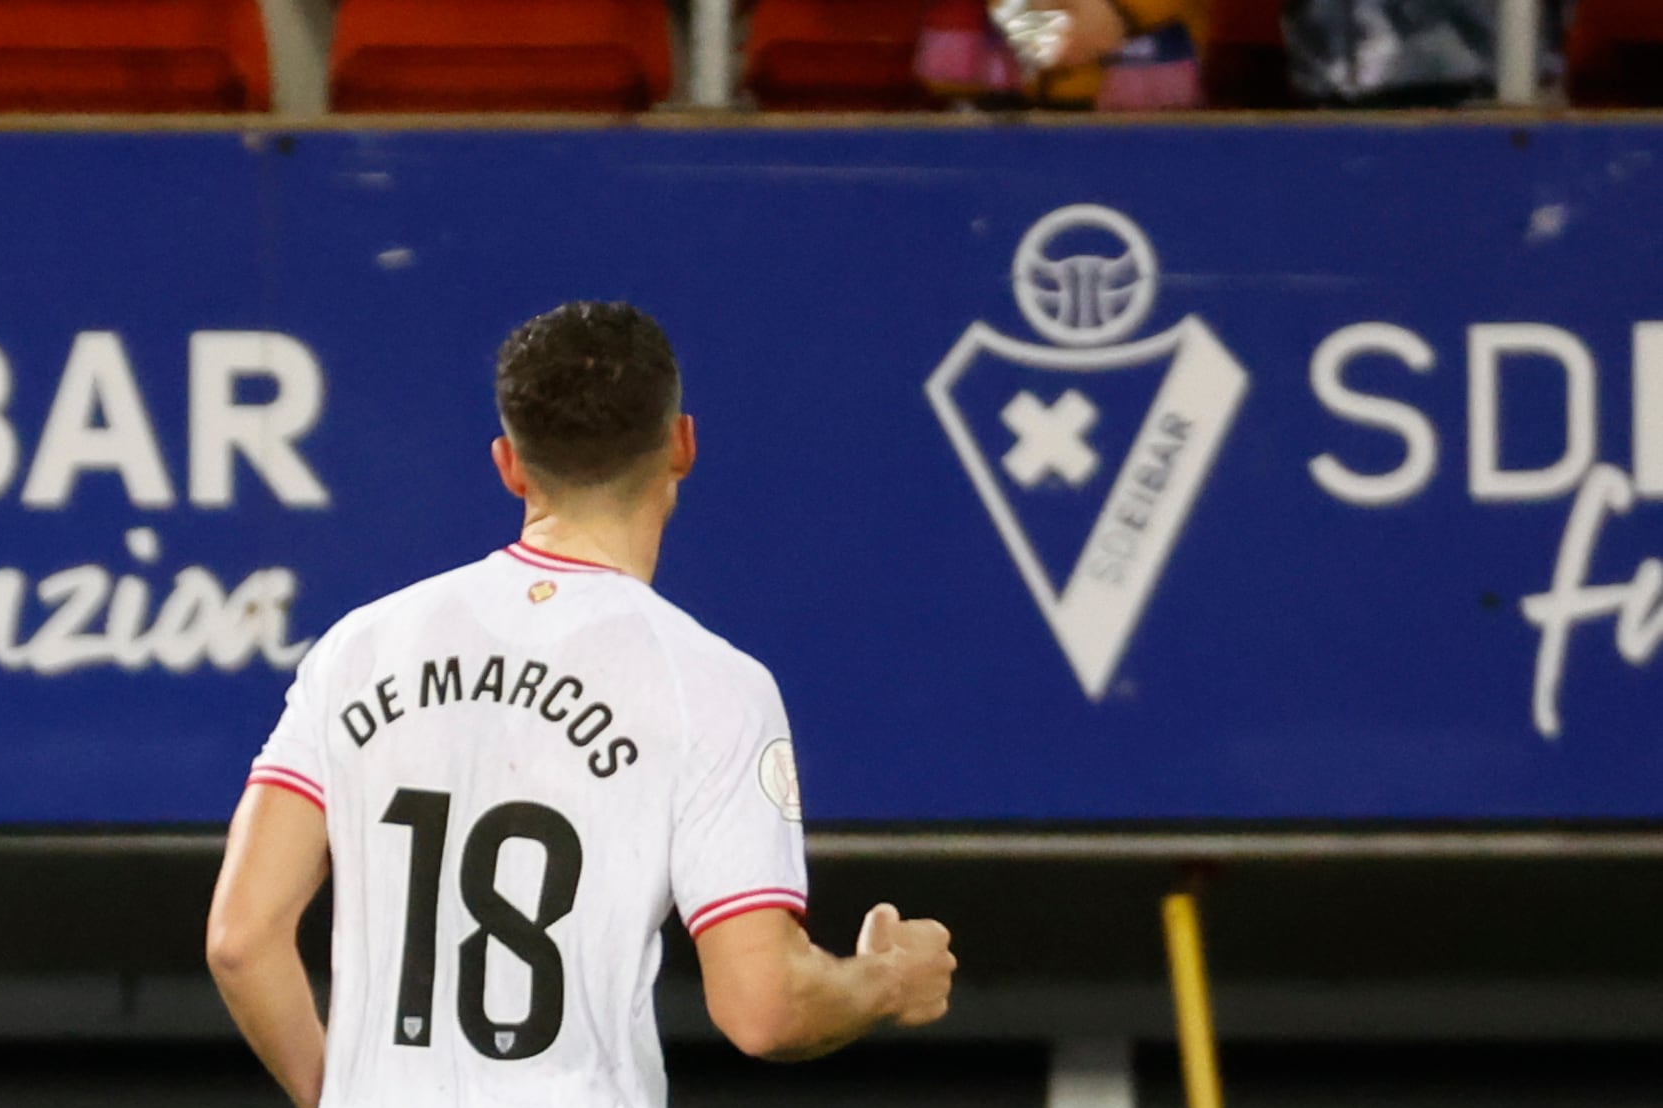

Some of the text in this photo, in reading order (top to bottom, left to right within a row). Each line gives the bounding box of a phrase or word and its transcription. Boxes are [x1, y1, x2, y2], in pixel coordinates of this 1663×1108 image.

[339, 655, 639, 779] DE MARCOS
[380, 786, 584, 1061] 18
